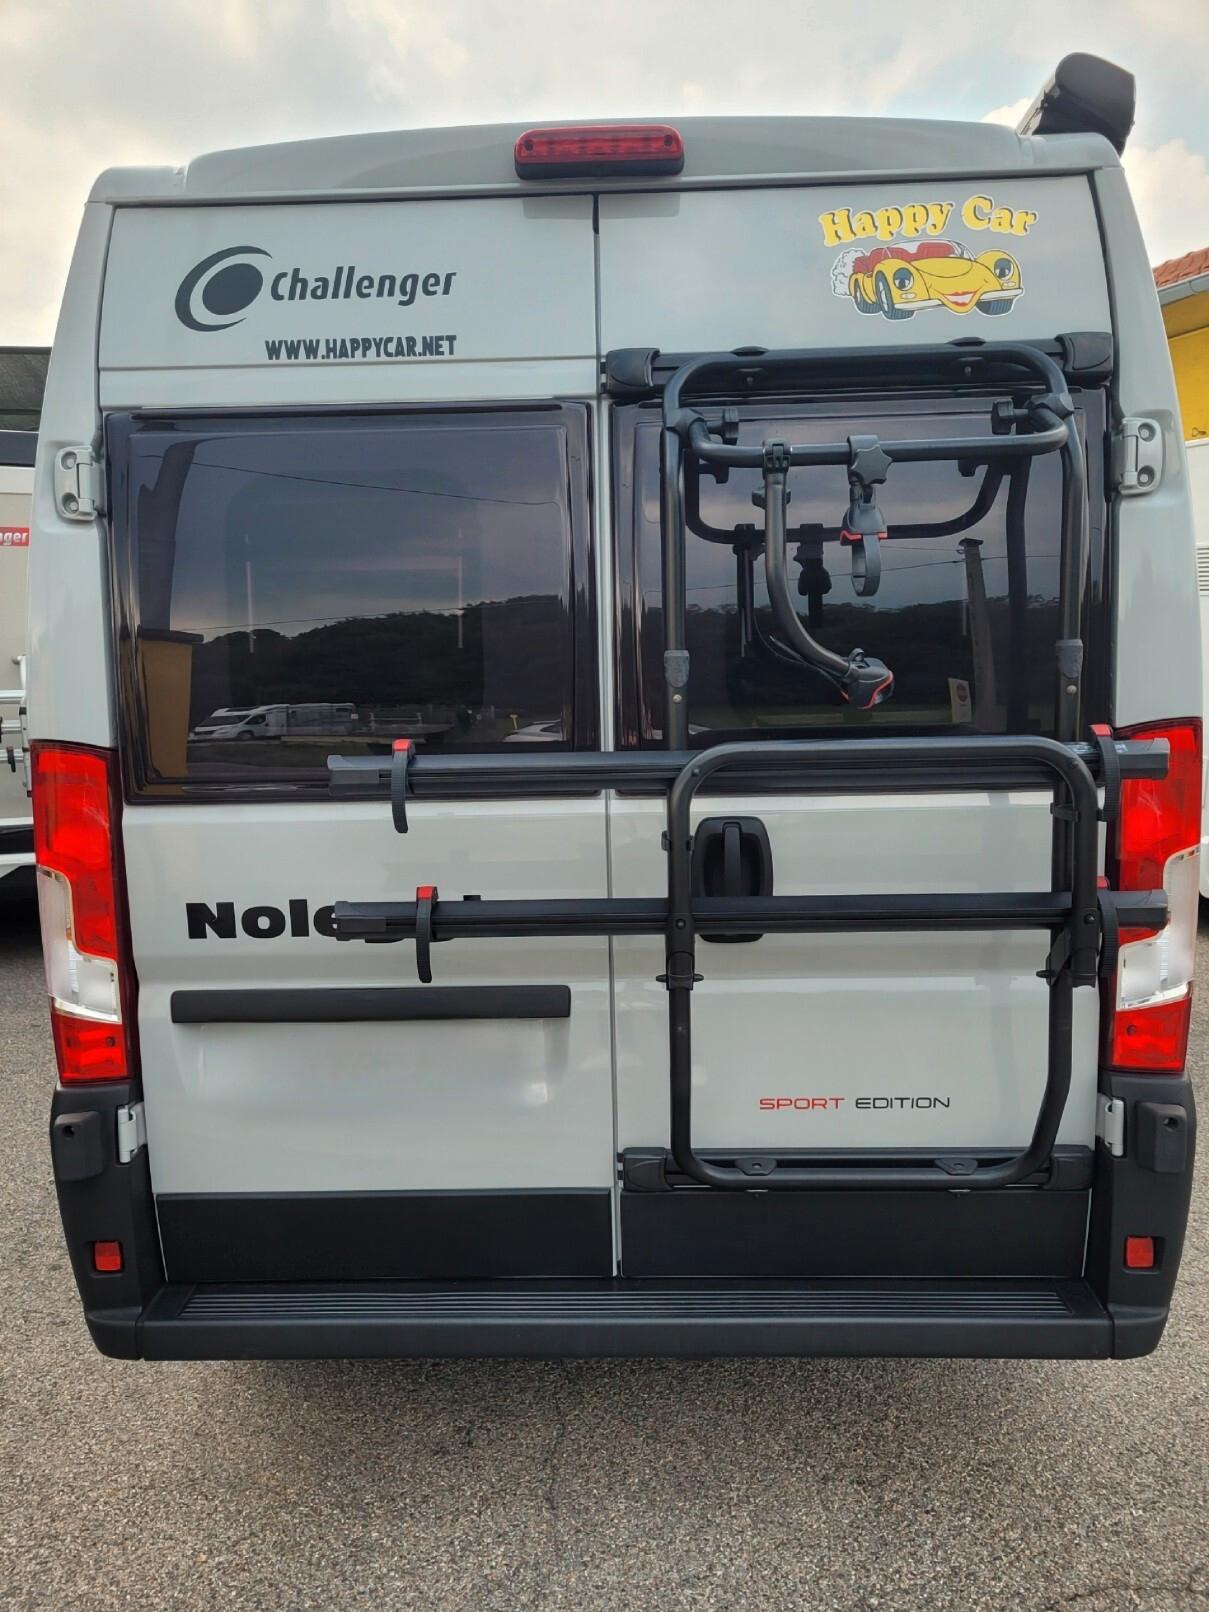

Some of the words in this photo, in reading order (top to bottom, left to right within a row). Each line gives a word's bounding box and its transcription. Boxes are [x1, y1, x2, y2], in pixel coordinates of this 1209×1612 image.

[818, 201, 955, 247] Happy
[961, 195, 1038, 236] Car
[270, 265, 457, 307] Challenger
[264, 334, 457, 361] WWW.HAPPYCAR.NET
[759, 1097, 845, 1110] SPORT
[855, 1096, 950, 1109] EDITION
